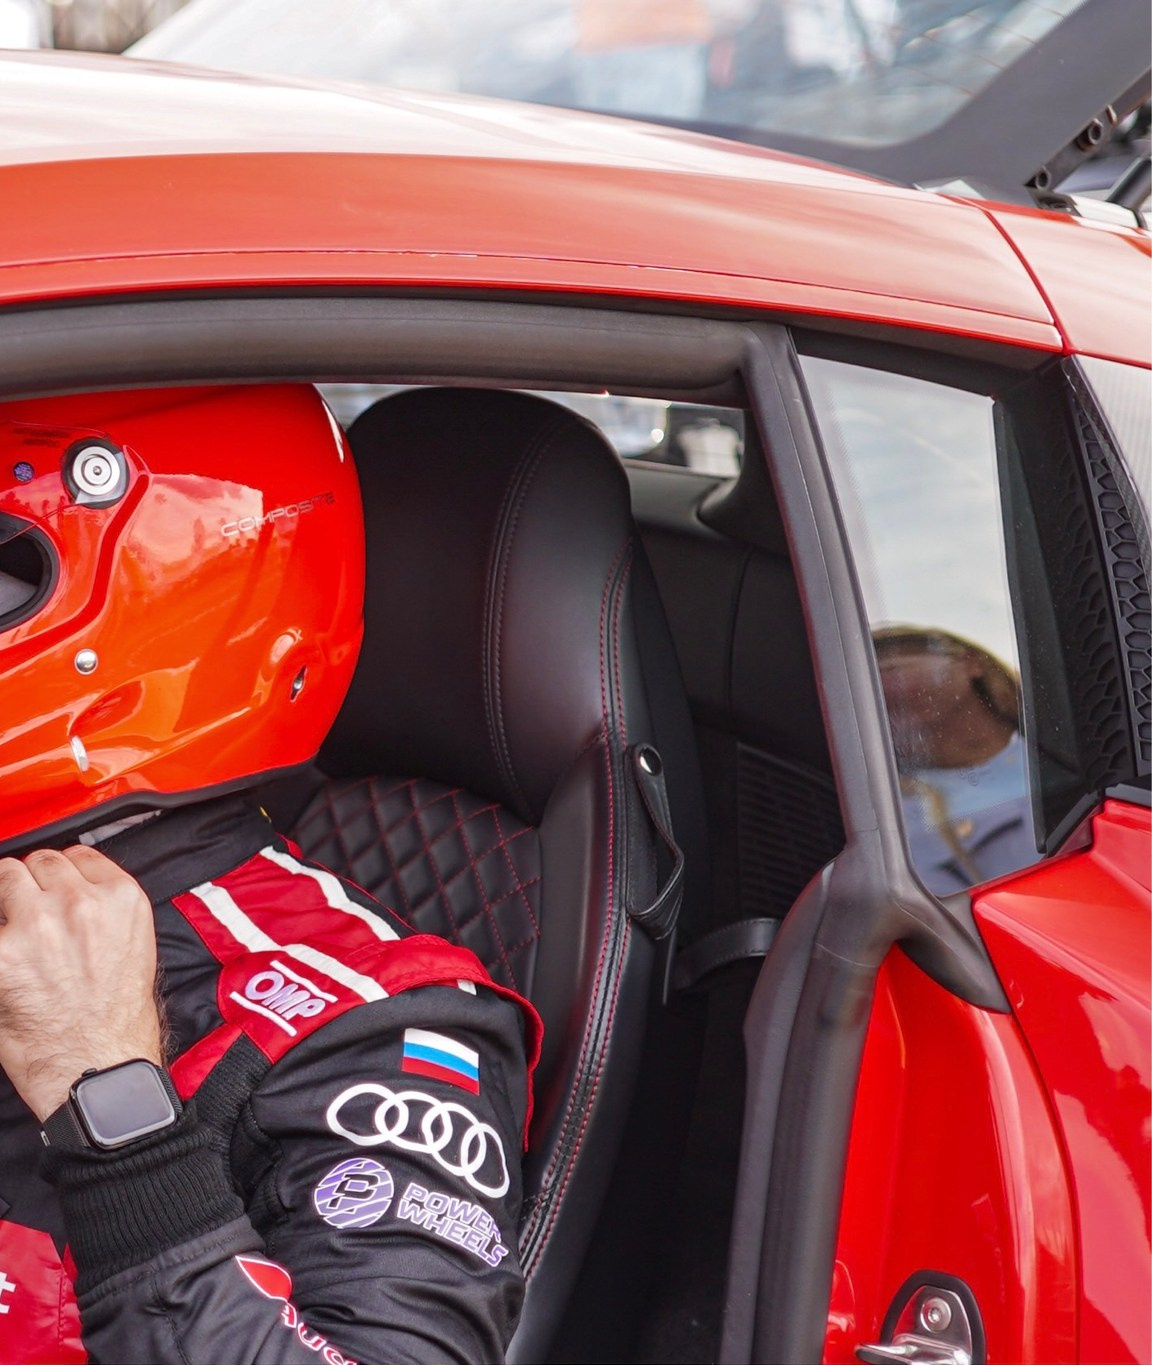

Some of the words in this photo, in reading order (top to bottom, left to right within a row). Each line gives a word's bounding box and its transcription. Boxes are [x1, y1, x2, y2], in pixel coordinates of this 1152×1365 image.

[245, 970, 326, 1021] OMP
[397, 1199, 509, 1268] WHEELS
[403, 1182, 503, 1244] POWER
[281, 1302, 357, 1365] Aud
